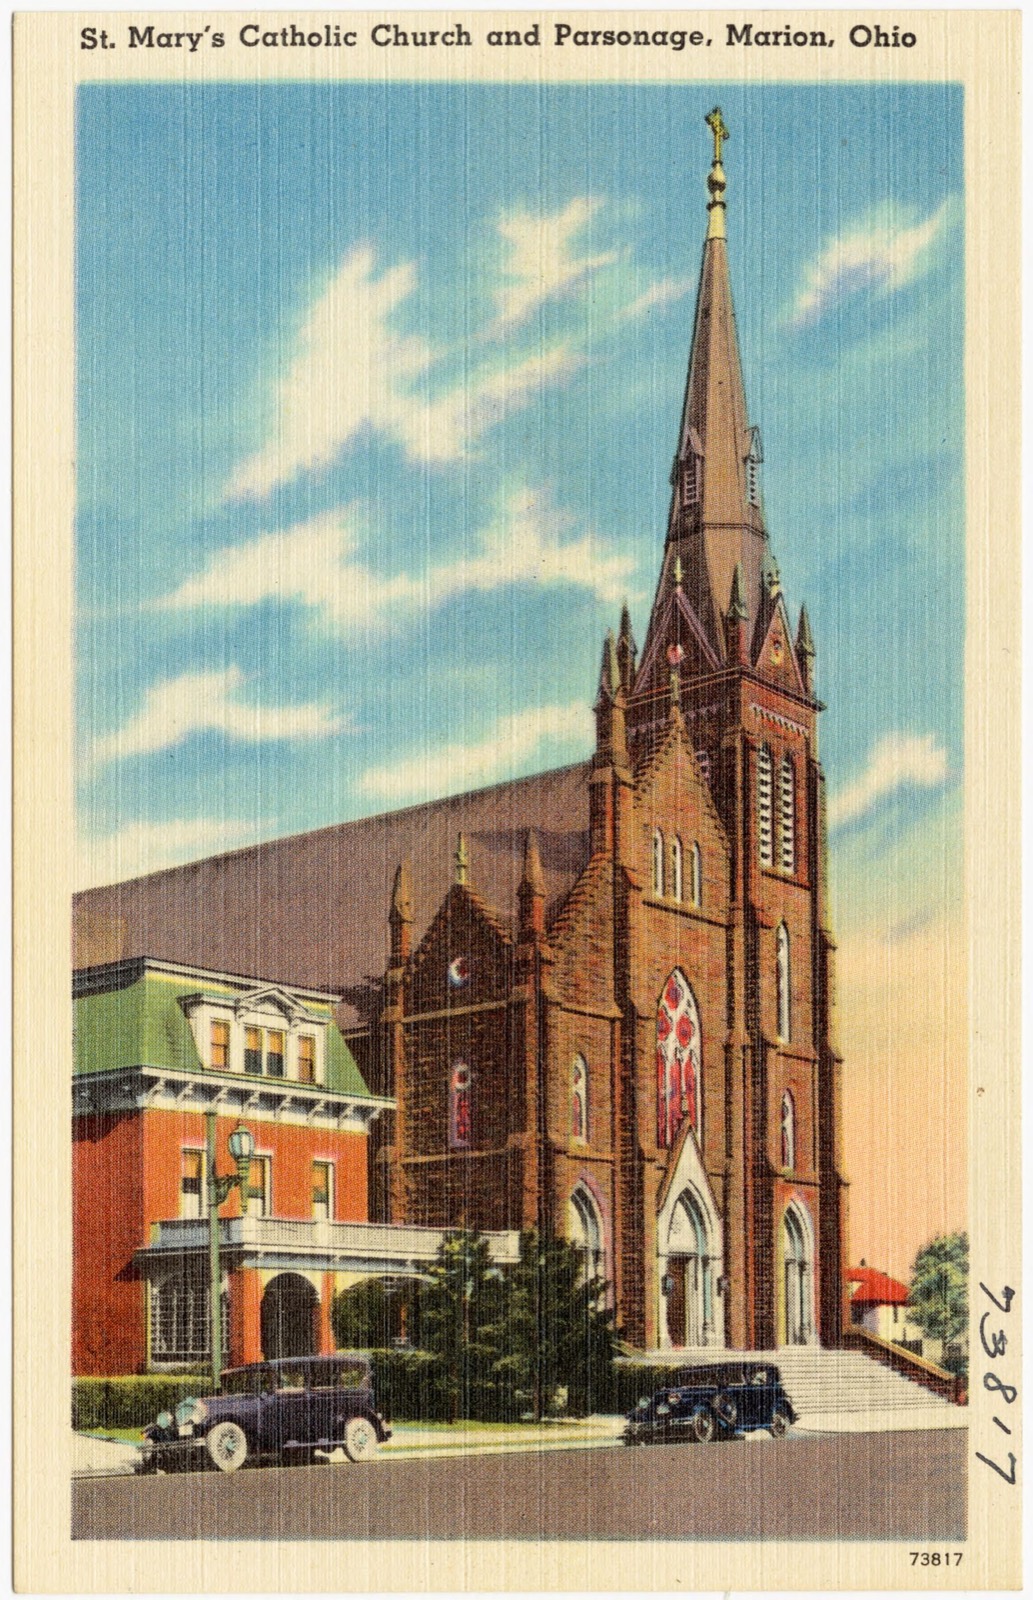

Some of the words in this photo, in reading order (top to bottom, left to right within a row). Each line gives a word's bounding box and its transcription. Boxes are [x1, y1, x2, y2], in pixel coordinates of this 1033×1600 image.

[80, 27, 116, 50] St.
[128, 25, 225, 53] Mary's
[239, 24, 357, 48] Catholic
[371, 23, 472, 47] Church
[486, 23, 541, 47] and
[554, 23, 713, 51] Parsonage,
[725, 23, 835, 49] Marion,
[849, 24, 917, 48] Ohio
[976, 1282, 1018, 1485] 73817
[909, 1552, 963, 1567] 73817
